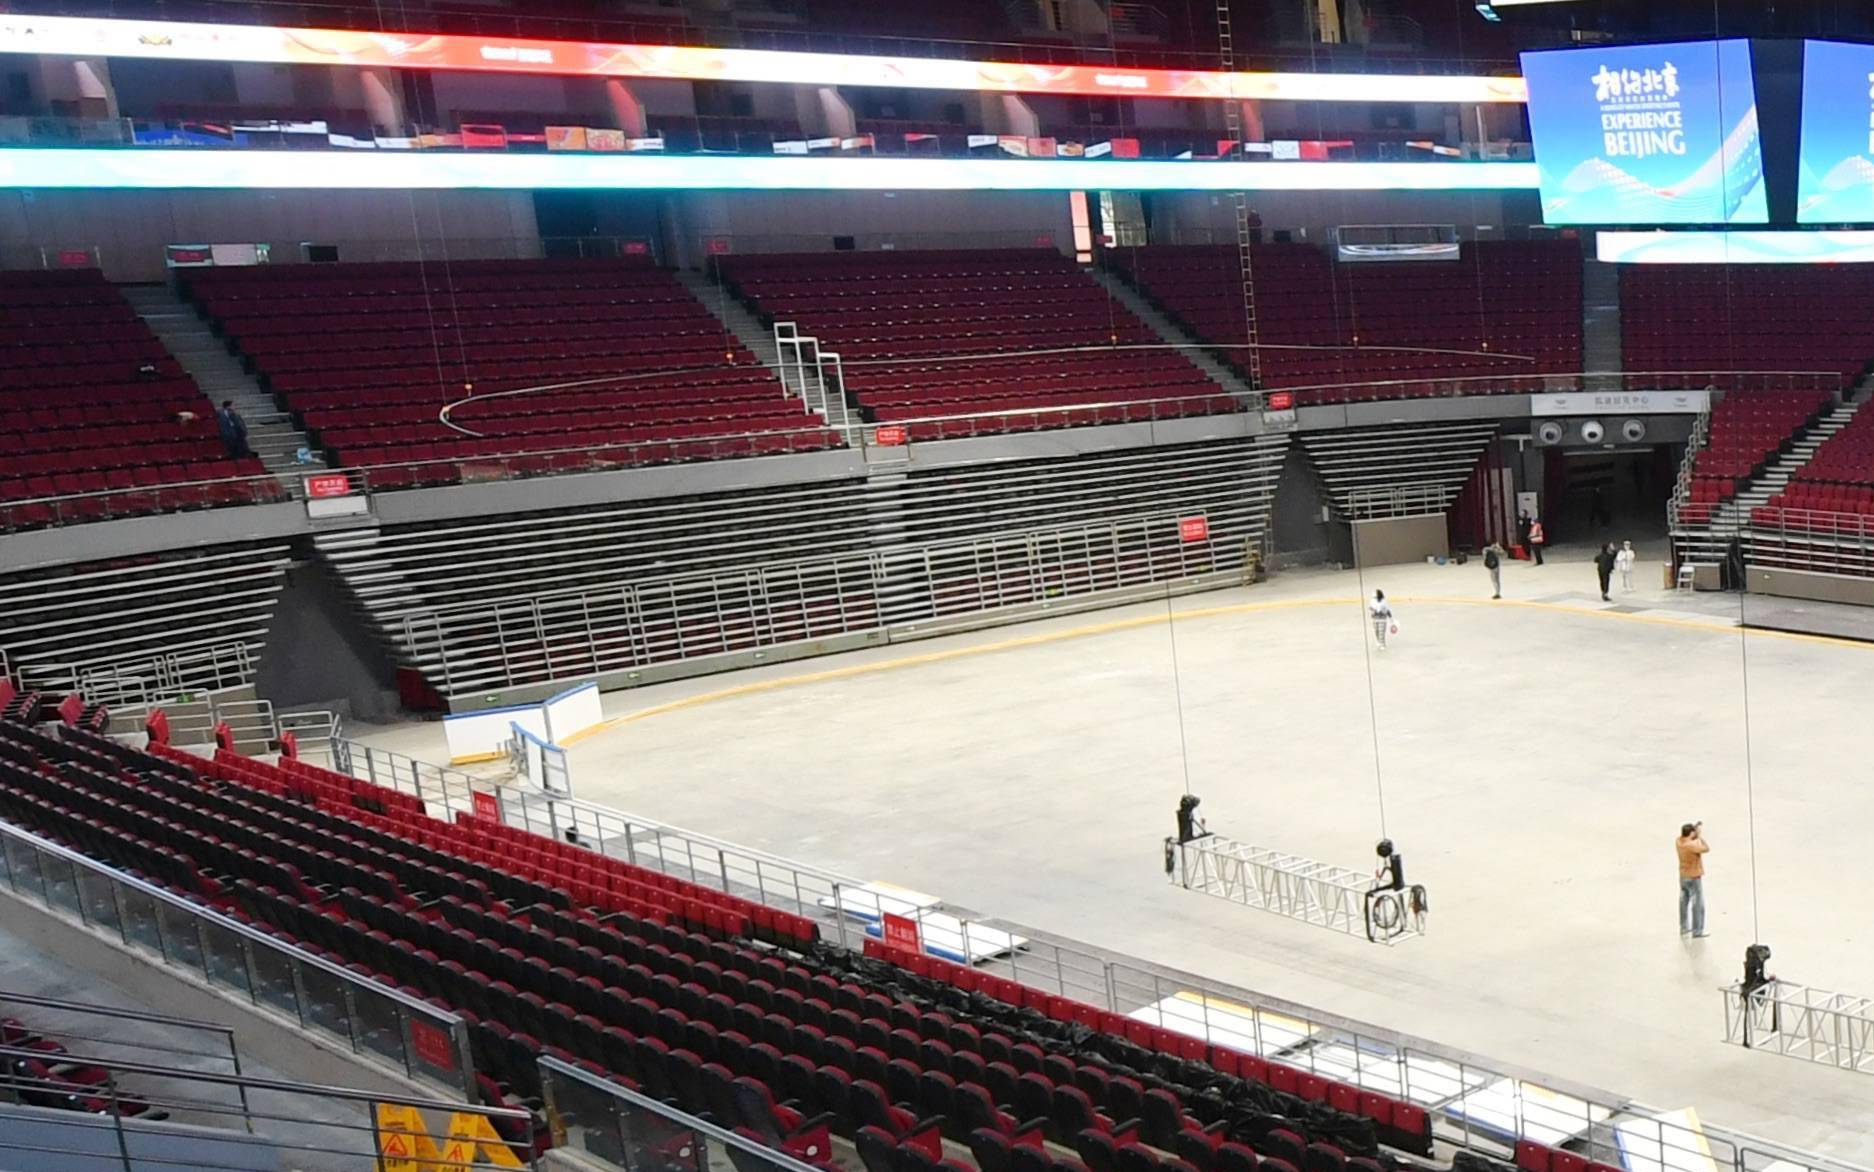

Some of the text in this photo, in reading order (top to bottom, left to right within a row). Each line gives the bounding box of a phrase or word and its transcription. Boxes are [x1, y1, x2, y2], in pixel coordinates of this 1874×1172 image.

[1591, 61, 1679, 102] 相约北京
[1601, 111, 1682, 130] EXPERIENCE
[1604, 129, 1686, 159] BEIJING
